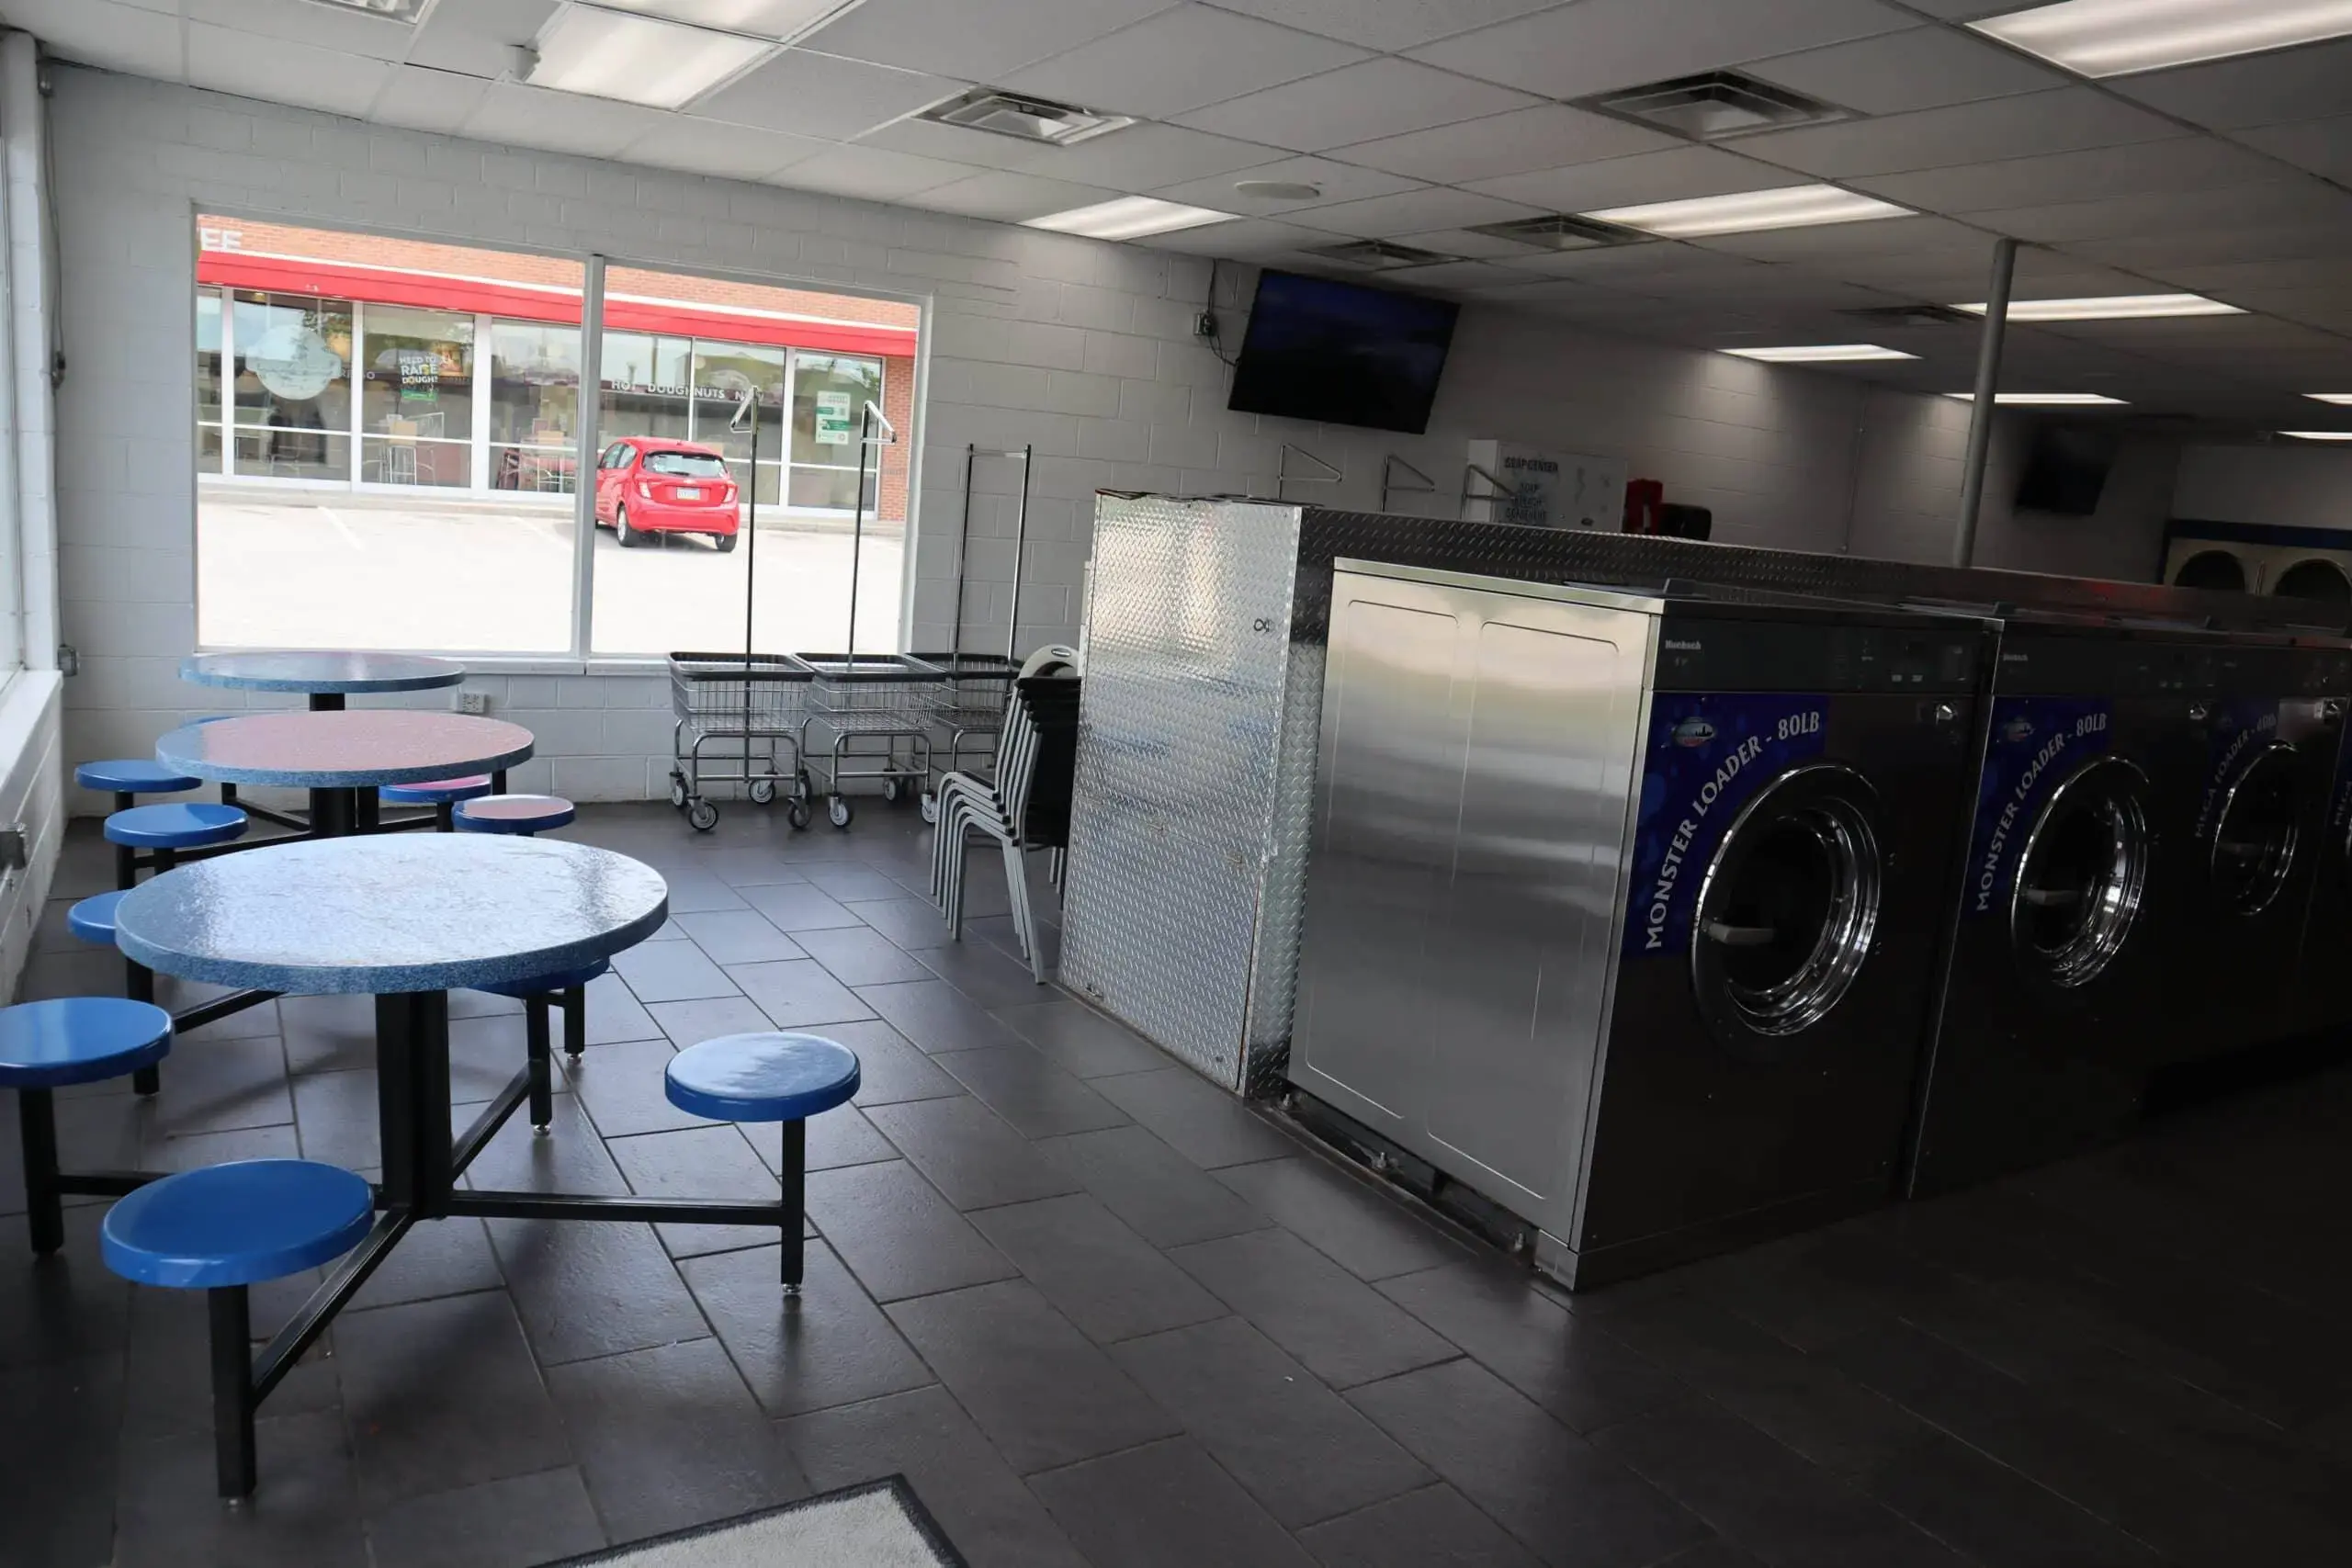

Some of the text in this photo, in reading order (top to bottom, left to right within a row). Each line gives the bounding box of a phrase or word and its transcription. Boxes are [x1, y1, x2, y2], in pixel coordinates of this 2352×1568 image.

[198, 228, 243, 251] EE
[611, 380, 636, 391] HOT
[1645, 818, 1698, 951] MONSTER
[1692, 735, 1763, 817] LOADER
[1777, 711, 1820, 740] 80LB
[1976, 801, 2019, 912] MONSTER
[2015, 731, 2065, 801] LOADER
[2075, 713, 2108, 738] 80LB
